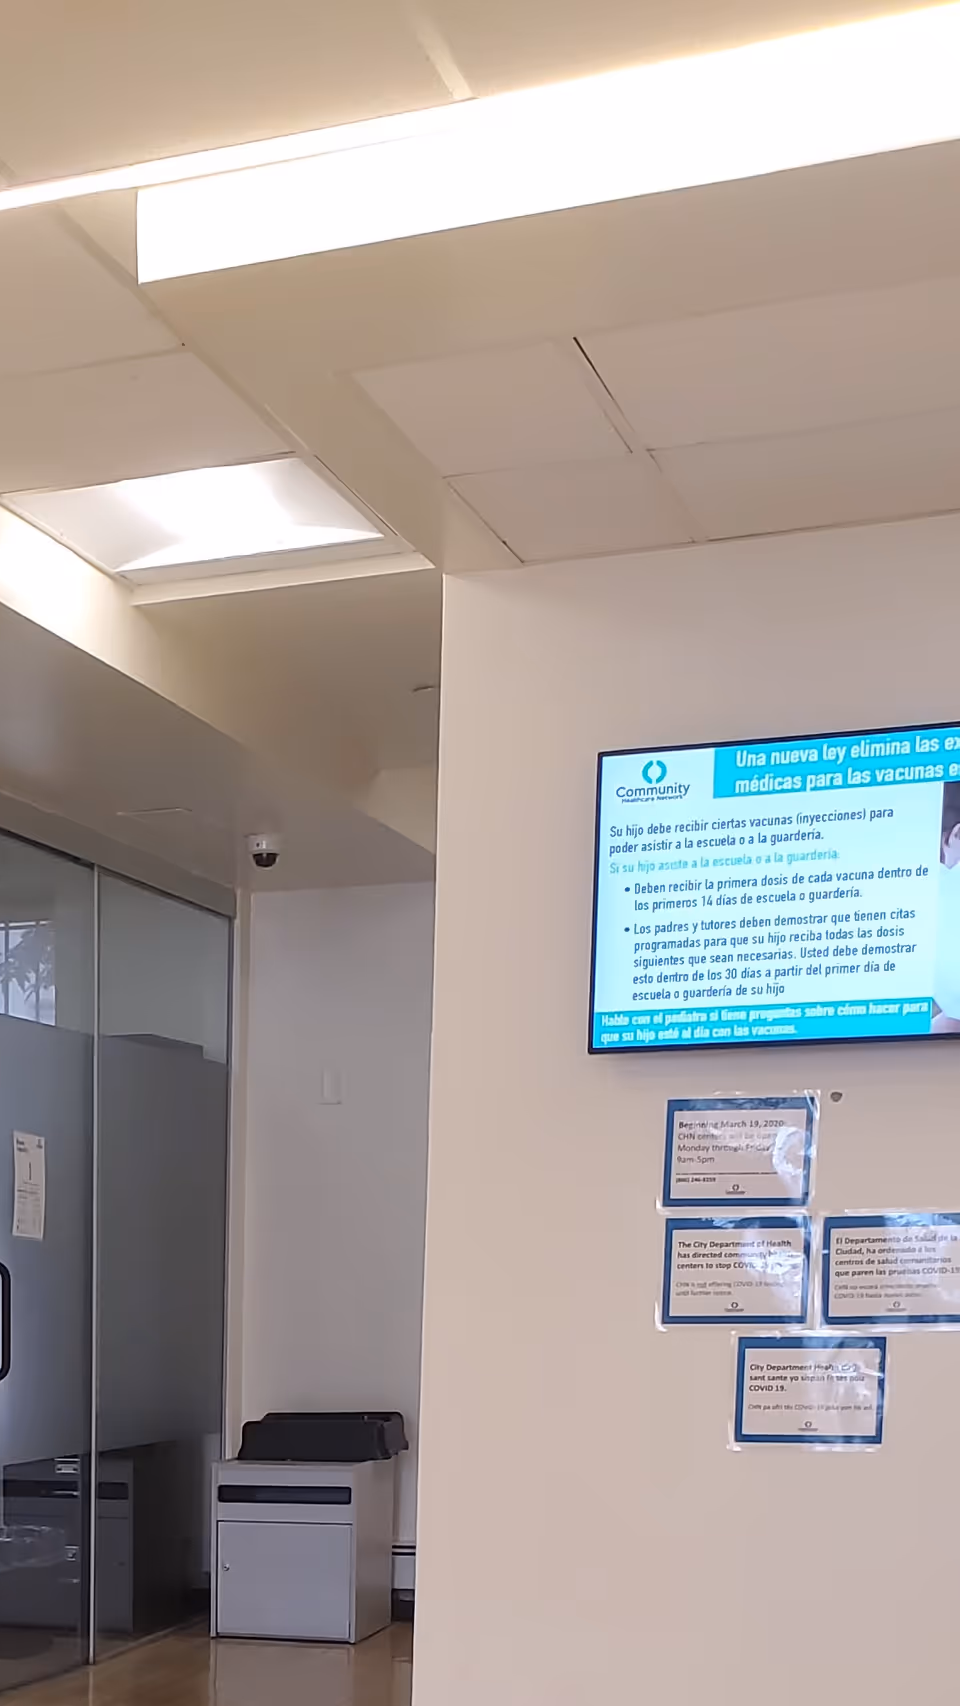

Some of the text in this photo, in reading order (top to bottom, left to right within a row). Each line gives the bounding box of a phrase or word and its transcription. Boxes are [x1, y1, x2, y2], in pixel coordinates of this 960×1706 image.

[736, 750, 766, 767] Una
[770, 749, 818, 765] nueva
[823, 743, 846, 765] ley
[851, 738, 910, 758] elimina
[915, 736, 939, 752] las
[735, 773, 802, 793] médicas
[806, 773, 842, 792] para
[848, 767, 871, 784] las
[875, 764, 944, 782] vacunas
[616, 782, 691, 799] Community
[609, 808, 894, 839] Su hijo debe recibir ciertas vacunas (inyecciones) para
[609, 829, 824, 857] poder asistir a la escuela o a la guardería.
[634, 864, 928, 894] Deben recibir la primera dosis de cada vacuna dentro de
[634, 899, 649, 911] los
[652, 898, 697, 913] primeros
[701, 895, 713, 907] 14
[716, 894, 737, 906] días
[740, 893, 753, 904] de
[756, 891, 796, 903] escuela
[809, 886, 863, 903] guardería.
[634, 908, 915, 936] Los padres y tutores deben demostrar que tienen citas
[634, 925, 905, 954] programadas para que su hijo reciba todas las dosis
[633, 943, 917, 970] siguientes que sean necesarias. Usted debe demostrar
[633, 974, 653, 984] esto
[656, 972, 689, 983] dentro
[692, 970, 704, 982] de
[707, 969, 722, 981] los
[725, 968, 737, 980] 30
[765, 969, 771, 978] a
[775, 965, 803, 980] partir
[806, 963, 822, 976] del
[825, 964, 861, 977] primer
[884, 960, 896, 972] de
[632, 983, 785, 1001] escuela o guardería de su hijo
[678, 1121, 718, 1130] Beginning
[721, 1120, 746, 1128] March
[750, 1120, 761, 1128] 19,
[678, 1144, 709, 1152] Monday
[693, 1241, 707, 1250] City
[709, 1241, 755, 1250] Department
[757, 1240, 765, 1248] of
[845, 1237, 901, 1245] Departamento
[692, 1251, 722, 1259] directed
[877, 1257, 898, 1265] salud
[715, 1262, 731, 1270] stop
[835, 1269, 850, 1277] que
[851, 1268, 874, 1277] paren
[876, 1267, 886, 1276] las
[750, 1364, 764, 1372] City
